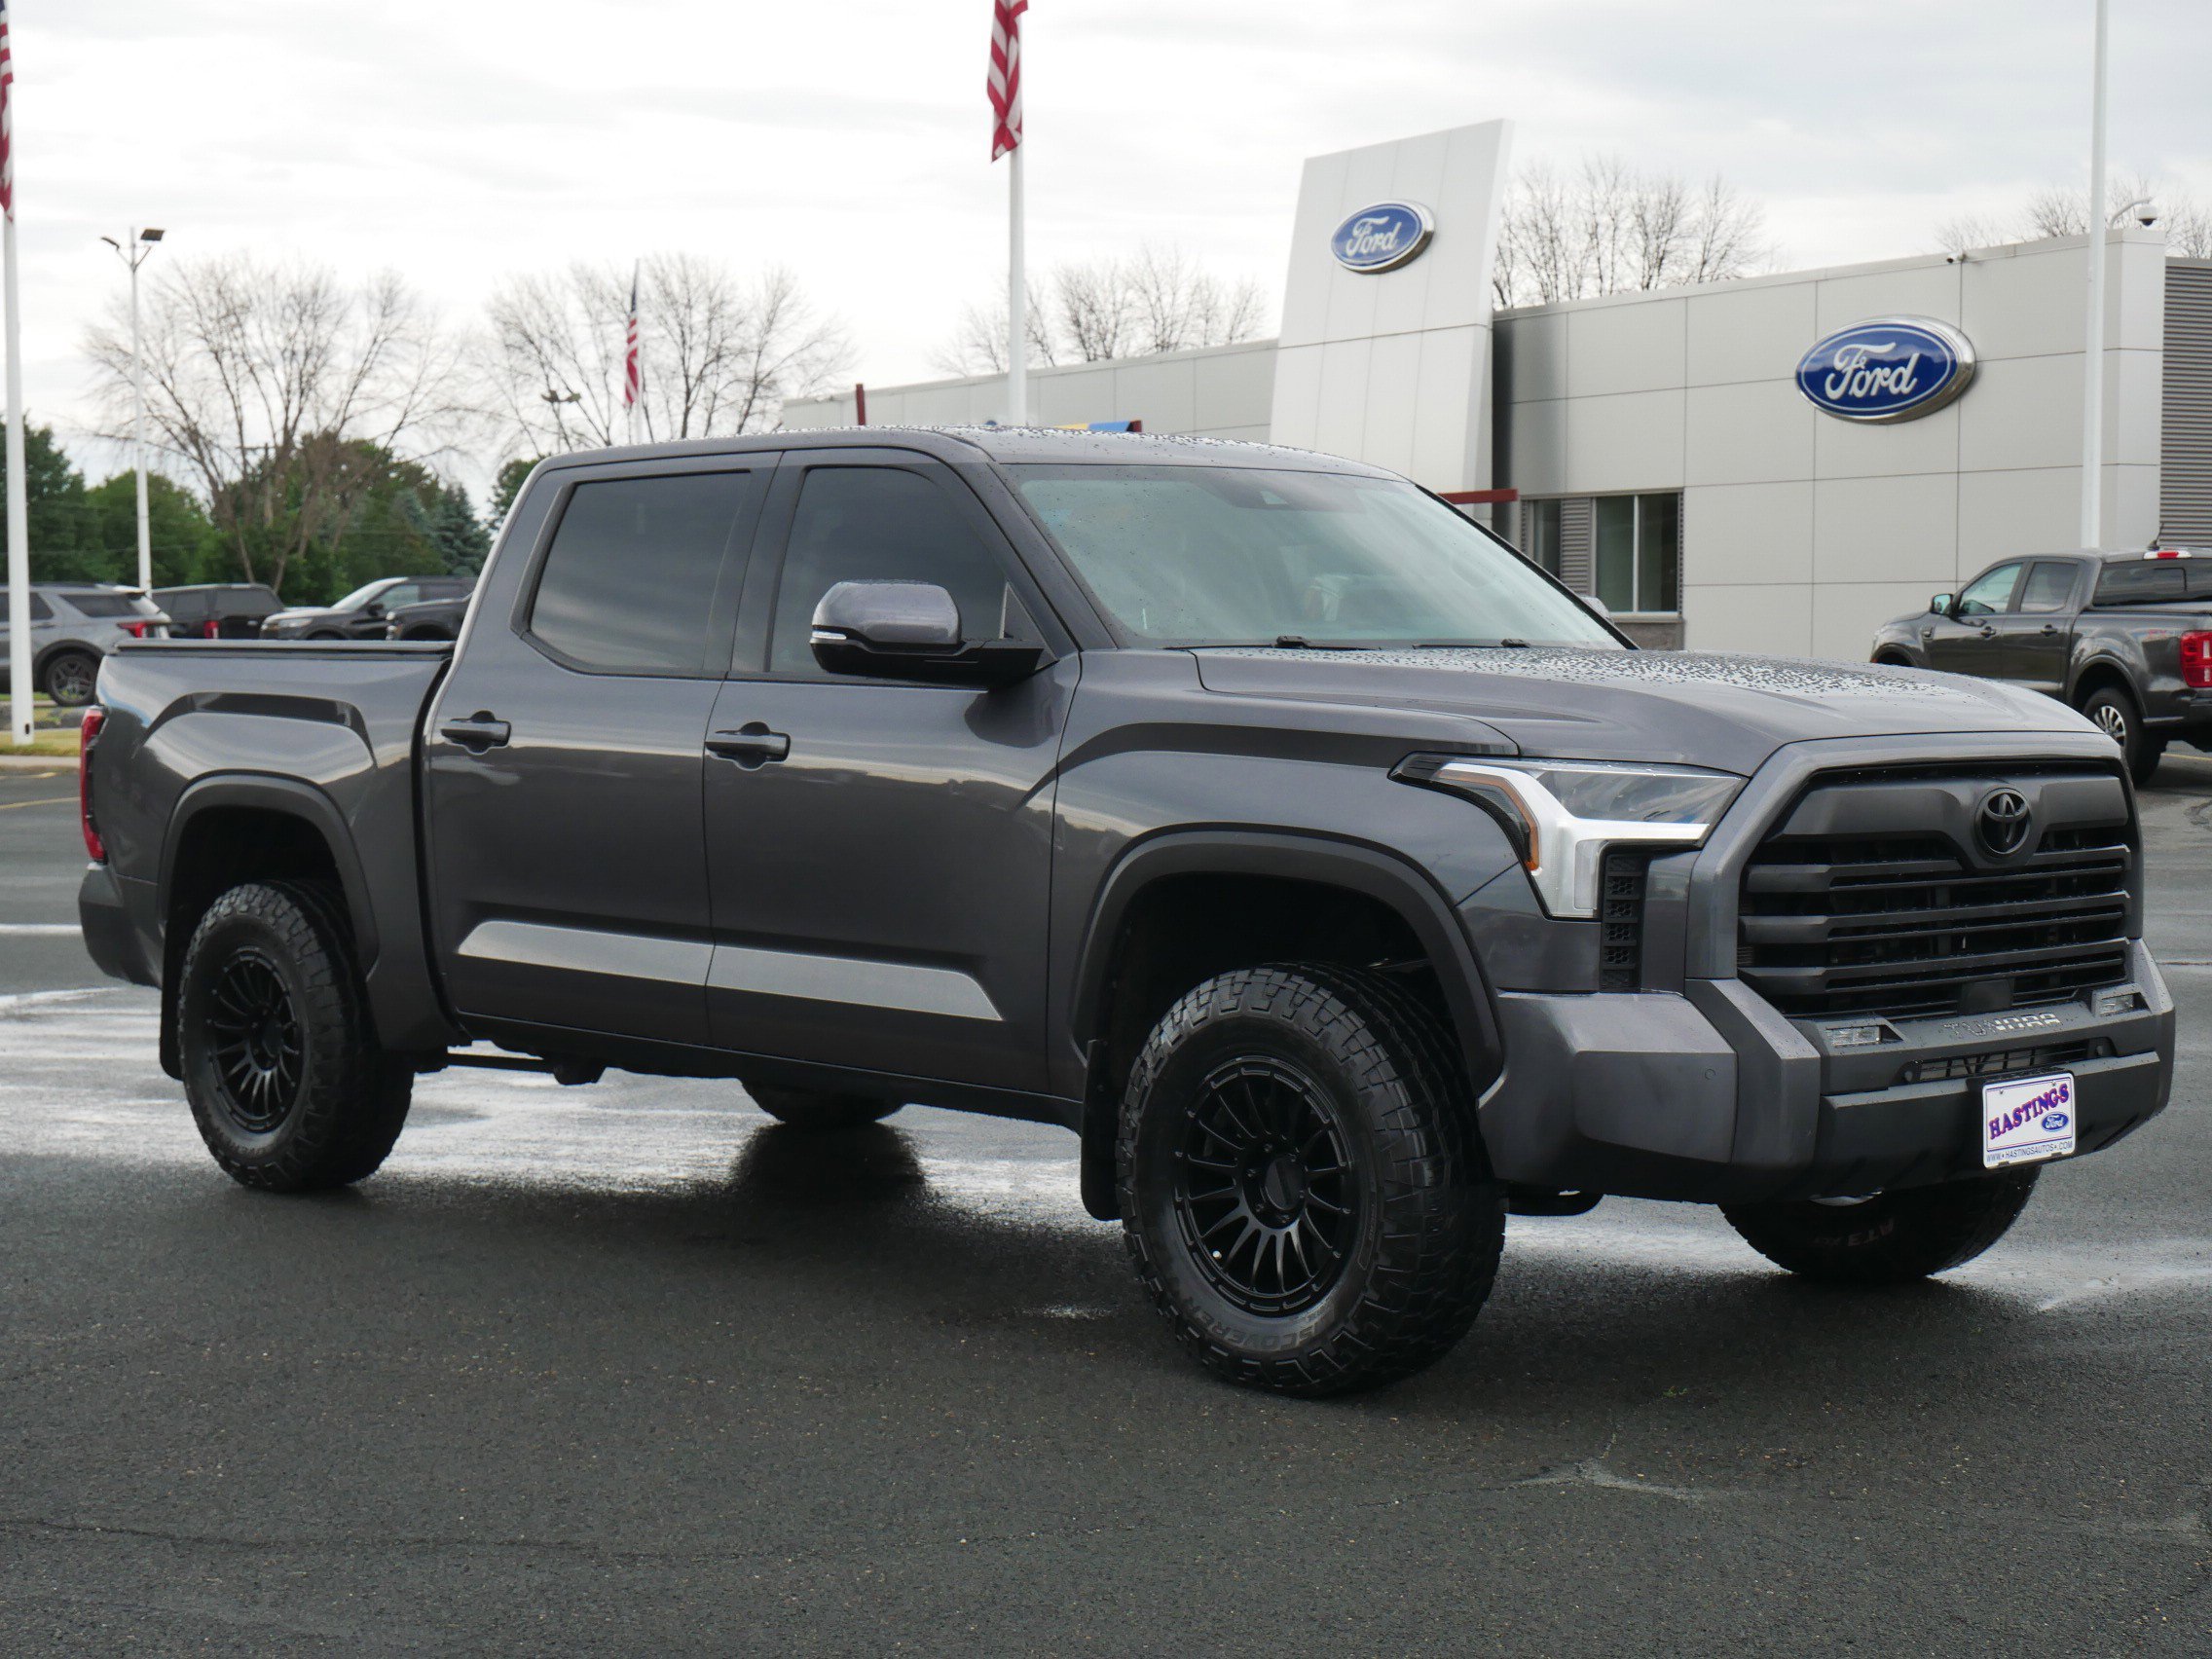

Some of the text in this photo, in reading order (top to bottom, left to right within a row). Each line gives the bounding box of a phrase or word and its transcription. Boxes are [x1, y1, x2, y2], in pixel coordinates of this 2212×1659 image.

[1346, 215, 1402, 257] Ford
[1825, 342, 1921, 400] Ford
[1989, 1083, 2069, 1140] HASTINGS
